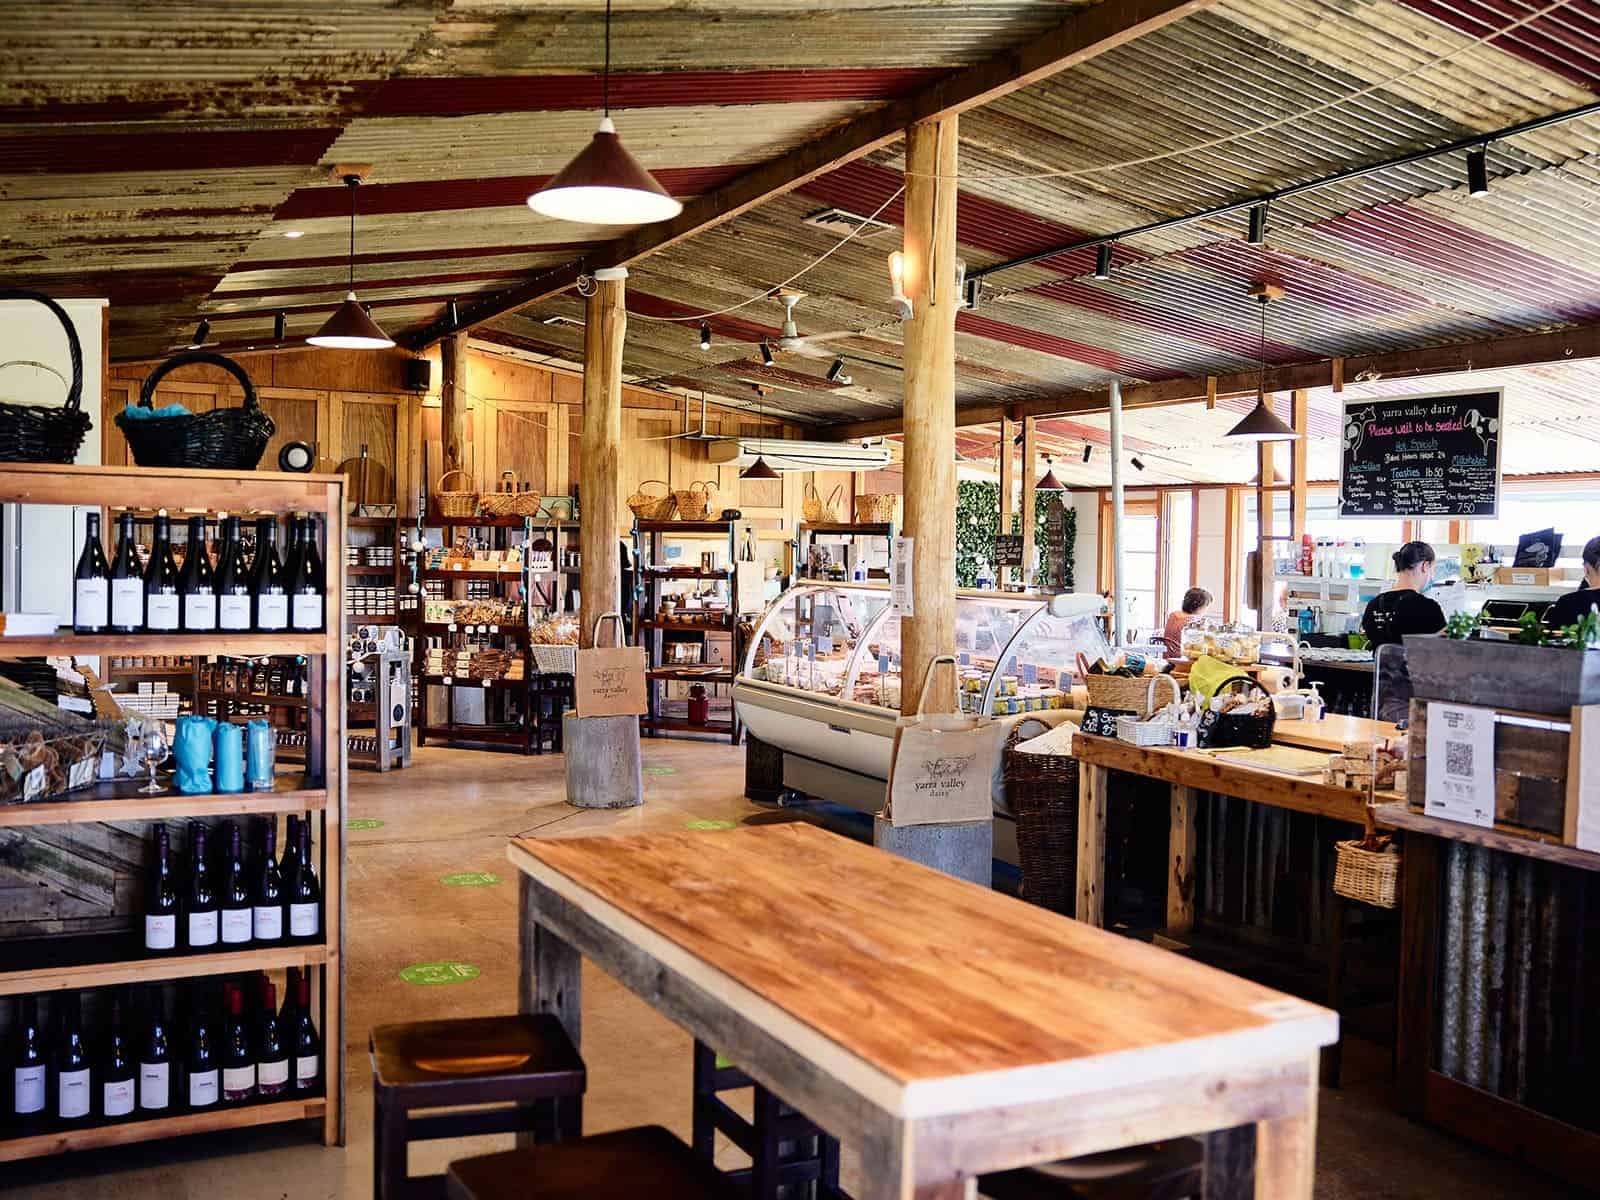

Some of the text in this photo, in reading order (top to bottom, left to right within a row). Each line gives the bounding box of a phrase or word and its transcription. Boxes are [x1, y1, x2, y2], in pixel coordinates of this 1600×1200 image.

[1382, 403, 1457, 420] yarra valley dairy
[1368, 424, 1393, 437] Please
[1416, 421, 1423, 432] to
[1425, 420, 1434, 432] be
[1435, 415, 1463, 432] seated
[1391, 467, 1420, 479] Toasties
[915, 778, 967, 791] yarra valley
